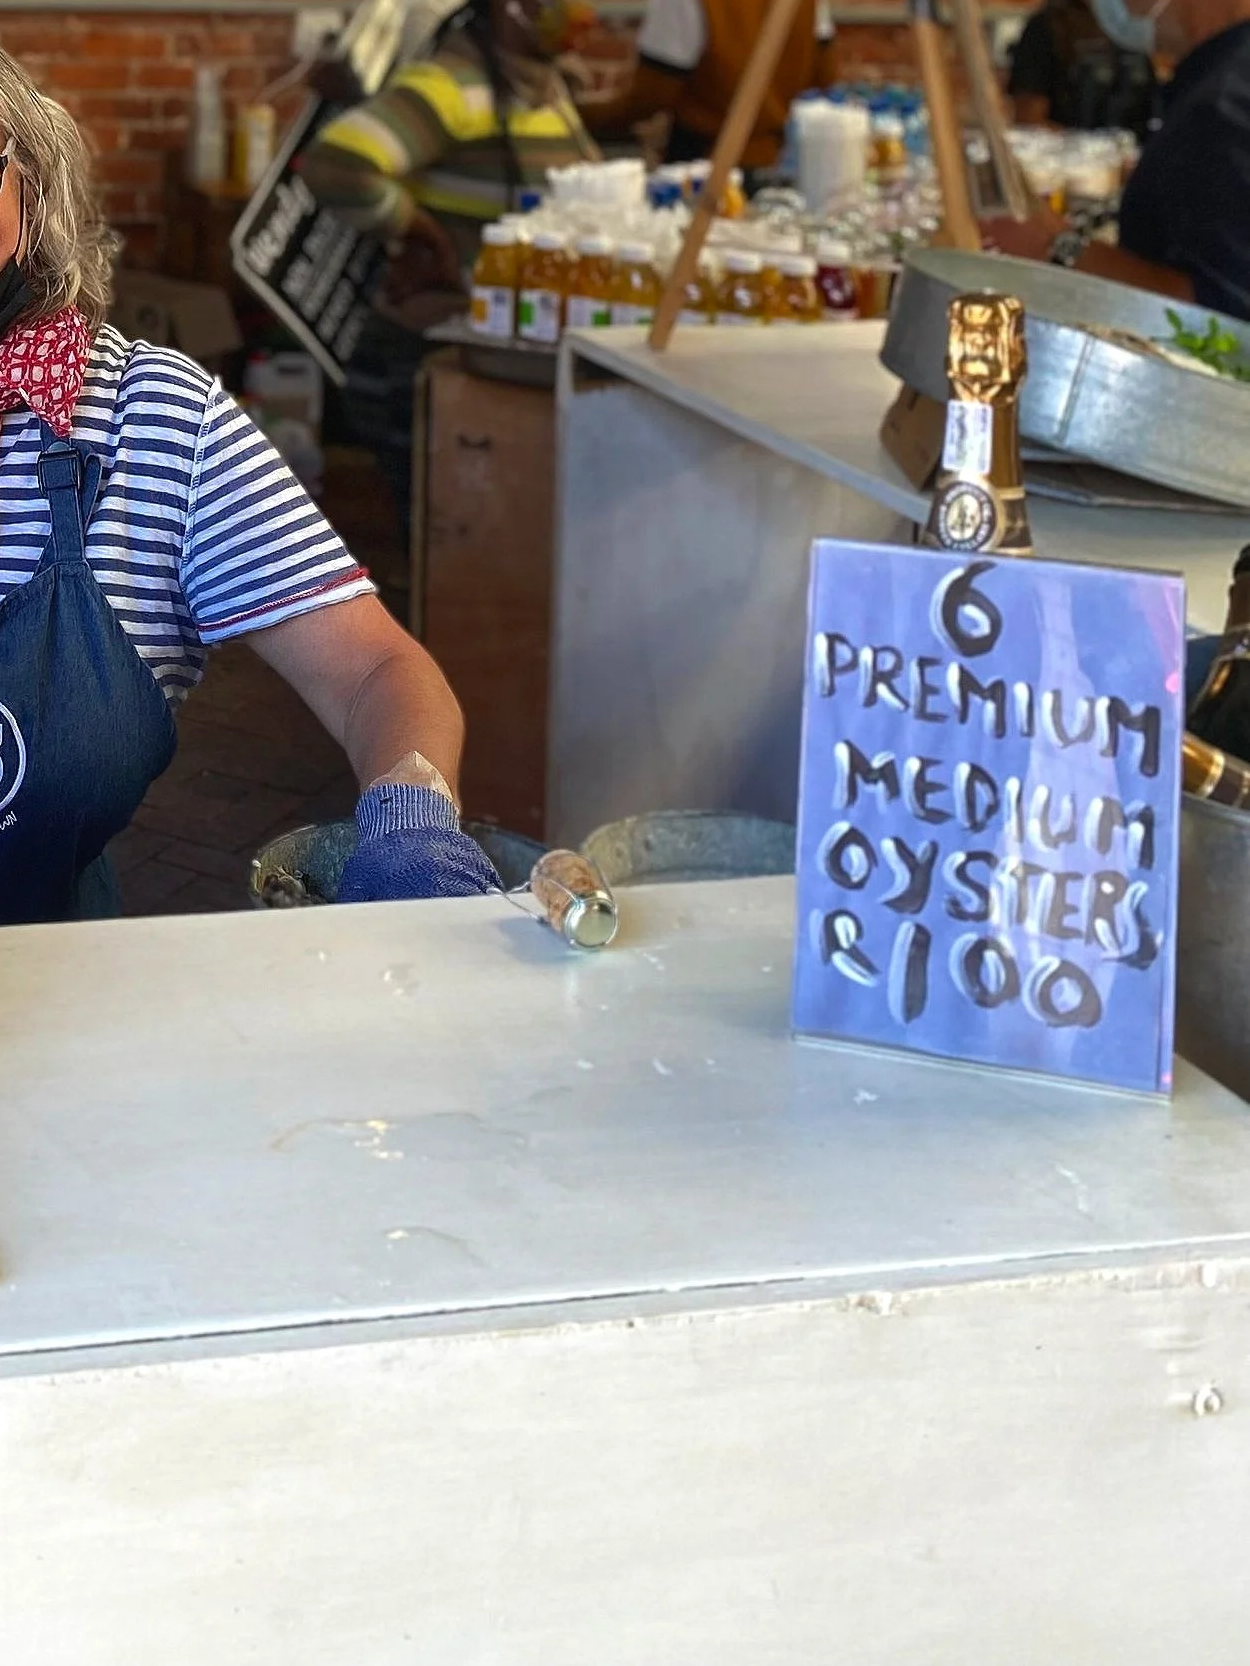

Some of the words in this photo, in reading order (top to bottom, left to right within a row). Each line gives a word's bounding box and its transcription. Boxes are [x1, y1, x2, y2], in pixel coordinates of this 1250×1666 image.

[930, 561, 1002, 659] 6
[814, 631, 1162, 778] PREMIUM
[833, 739, 1156, 872] MEDIUM
[817, 820, 1164, 970] OYSTERS
[812, 908, 1104, 1029] R100
